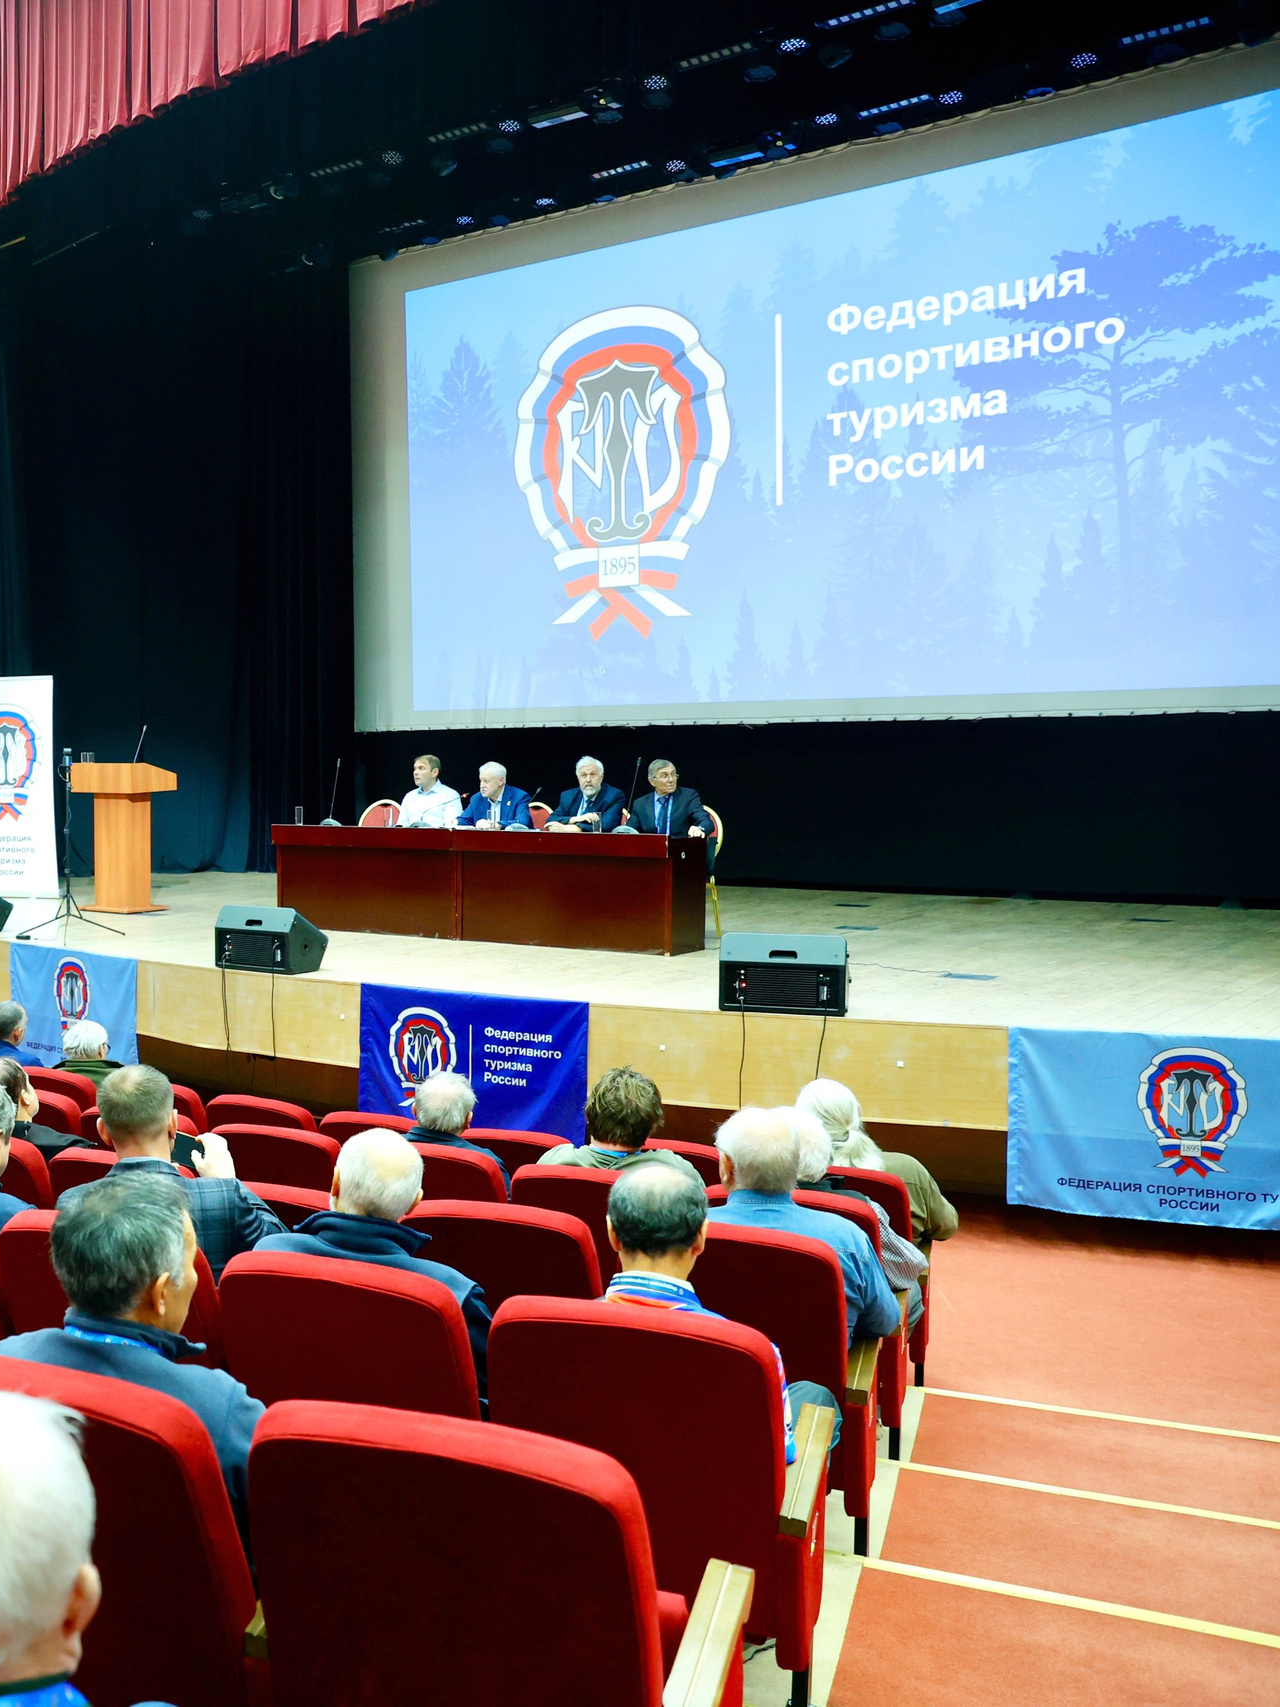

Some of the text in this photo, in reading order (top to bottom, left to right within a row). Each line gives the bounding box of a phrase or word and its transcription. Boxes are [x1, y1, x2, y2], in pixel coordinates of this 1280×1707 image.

[827, 266, 1086, 337] Федерация
[826, 316, 1125, 387] спортивного
[826, 389, 1008, 443] туризма
[827, 444, 985, 487] России
[600, 555, 637, 577] 1895
[484, 1026, 553, 1044] Федерация
[26, 1041, 56, 1052] ФЕДЕРАЦИЯ
[483, 1043, 562, 1060] спортивного
[483, 1059, 533, 1073] туризма
[483, 1072, 527, 1087] России
[1181, 1143, 1200, 1154] 1895
[1056, 1176, 1142, 1193] ФЕДЕРАЦИЯ
[1146, 1183, 1257, 1203] СПОРТИВНОГО
[1159, 1198, 1220, 1213] РОССИИ
